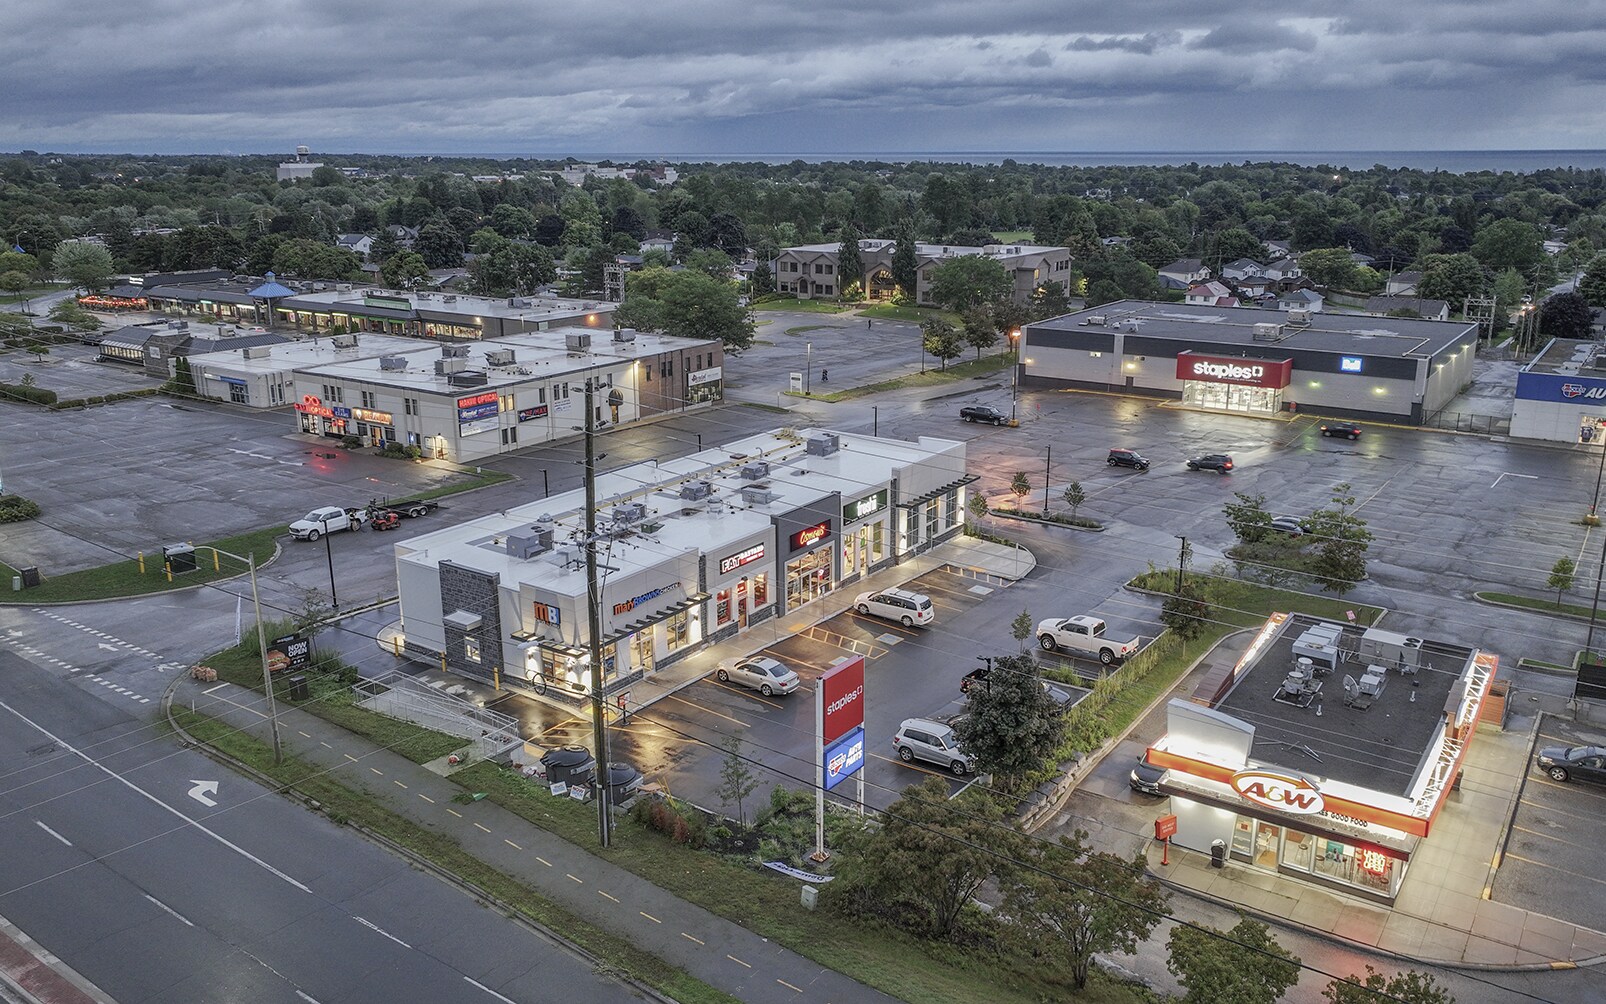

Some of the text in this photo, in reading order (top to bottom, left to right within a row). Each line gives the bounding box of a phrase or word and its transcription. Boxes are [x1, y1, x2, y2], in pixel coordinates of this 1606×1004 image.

[1193, 361, 1252, 379] staples
[721, 556, 741, 573] FAT
[534, 601, 560, 625] MB
[288, 641, 307, 652] NOW
[288, 647, 307, 657] OPEN
[827, 689, 858, 715] staples
[1241, 782, 1317, 809] A&W
[1330, 812, 1349, 823] GOOD
[1350, 817, 1368, 828] FOOD
[1363, 860, 1384, 873] OPEN
